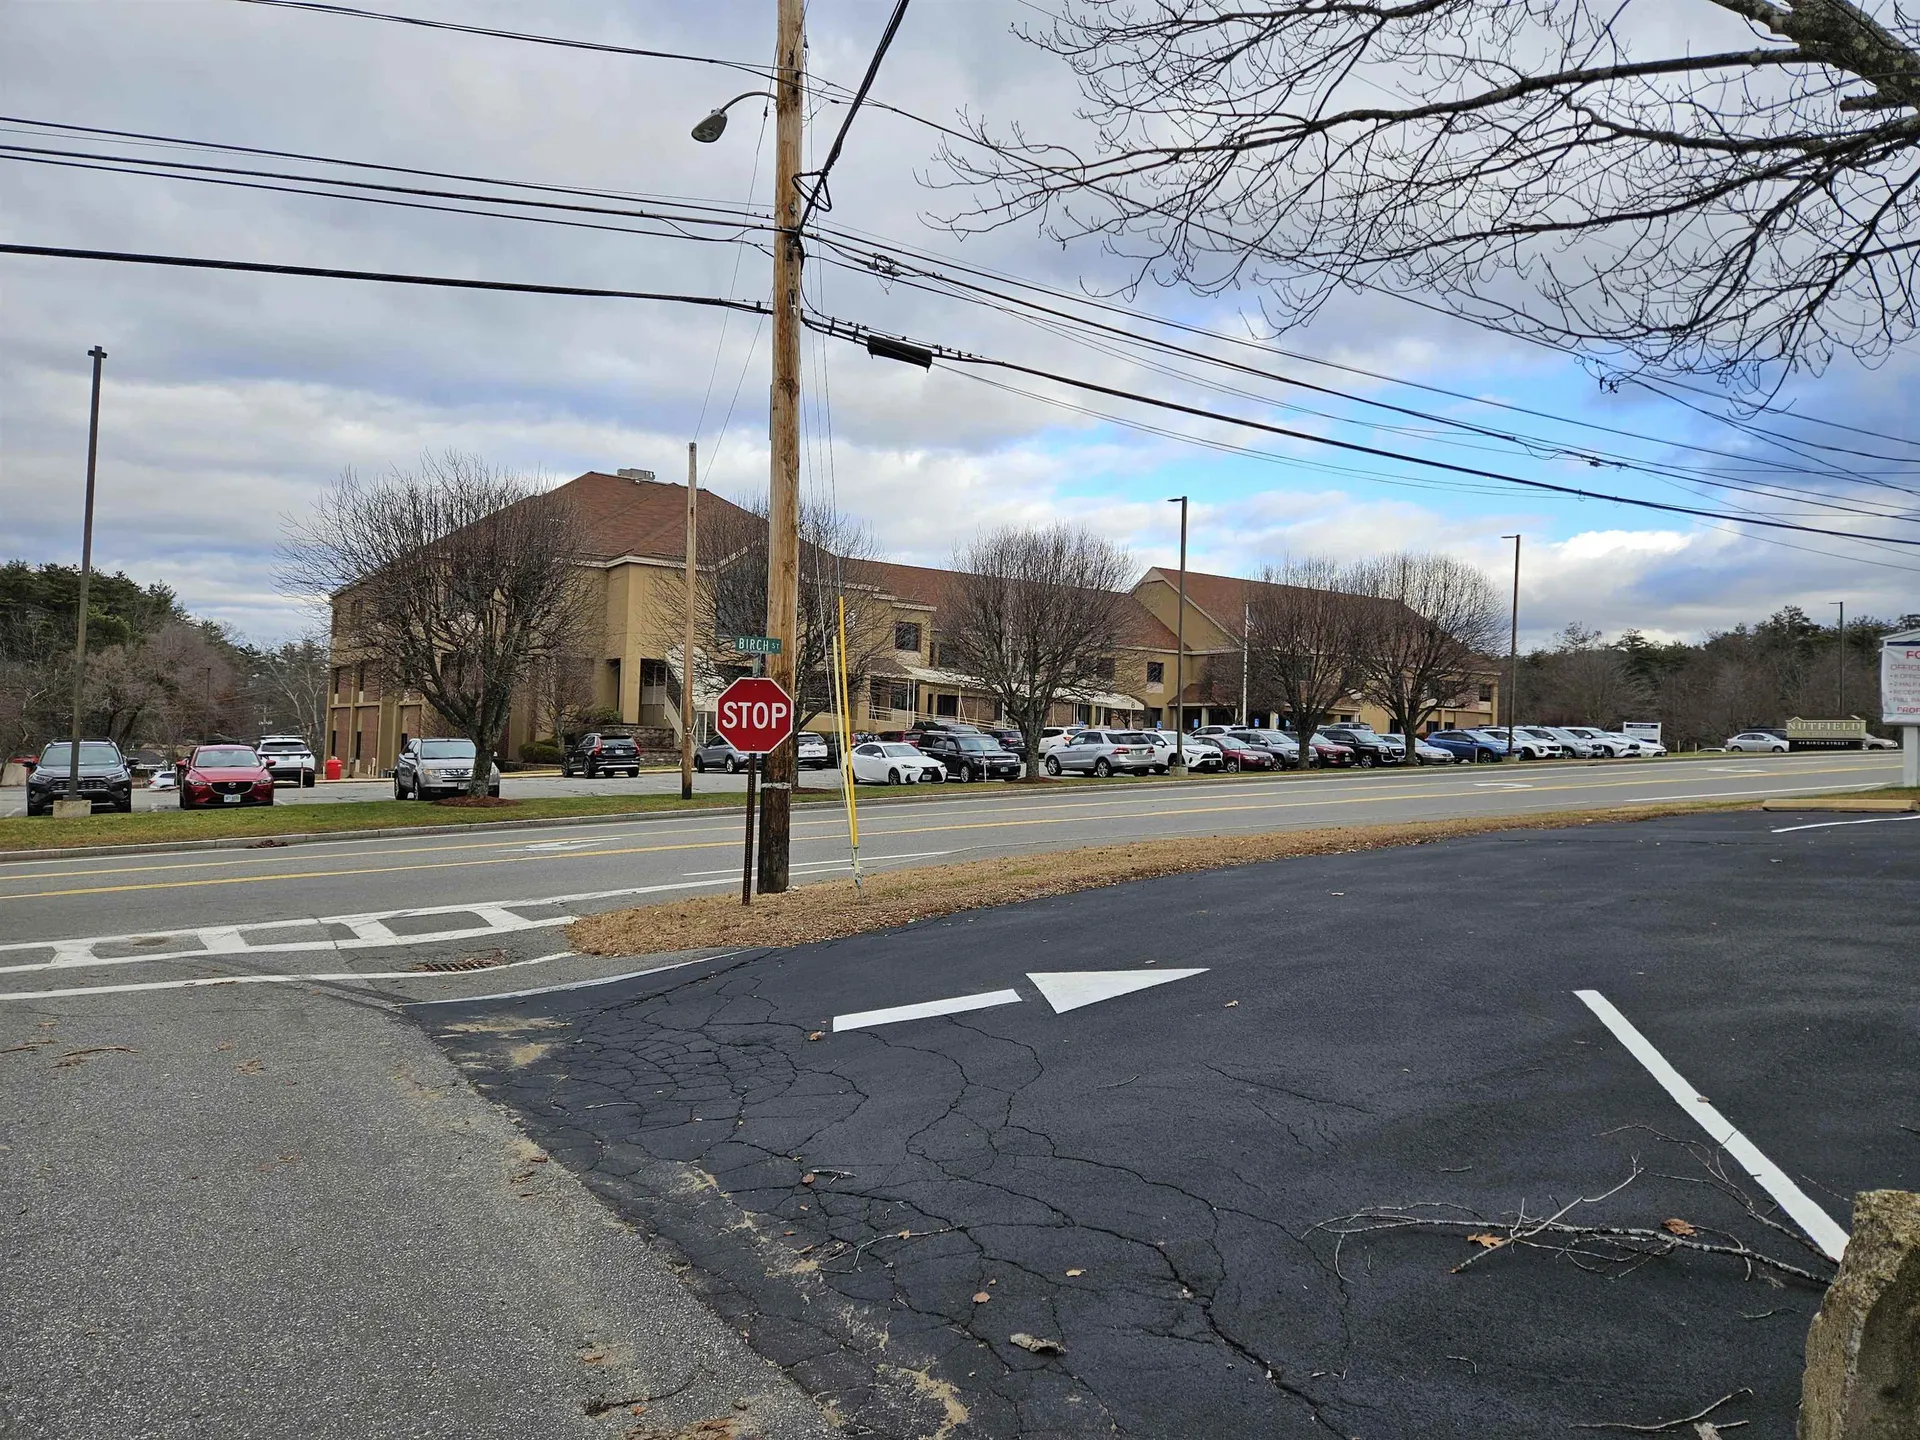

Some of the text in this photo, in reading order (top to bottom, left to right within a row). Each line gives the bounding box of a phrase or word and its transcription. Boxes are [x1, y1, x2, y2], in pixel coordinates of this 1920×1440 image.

[739, 638, 769, 651] BIRCH
[721, 701, 787, 729] STOP
[1788, 723, 1860, 731] NUTFIELD
